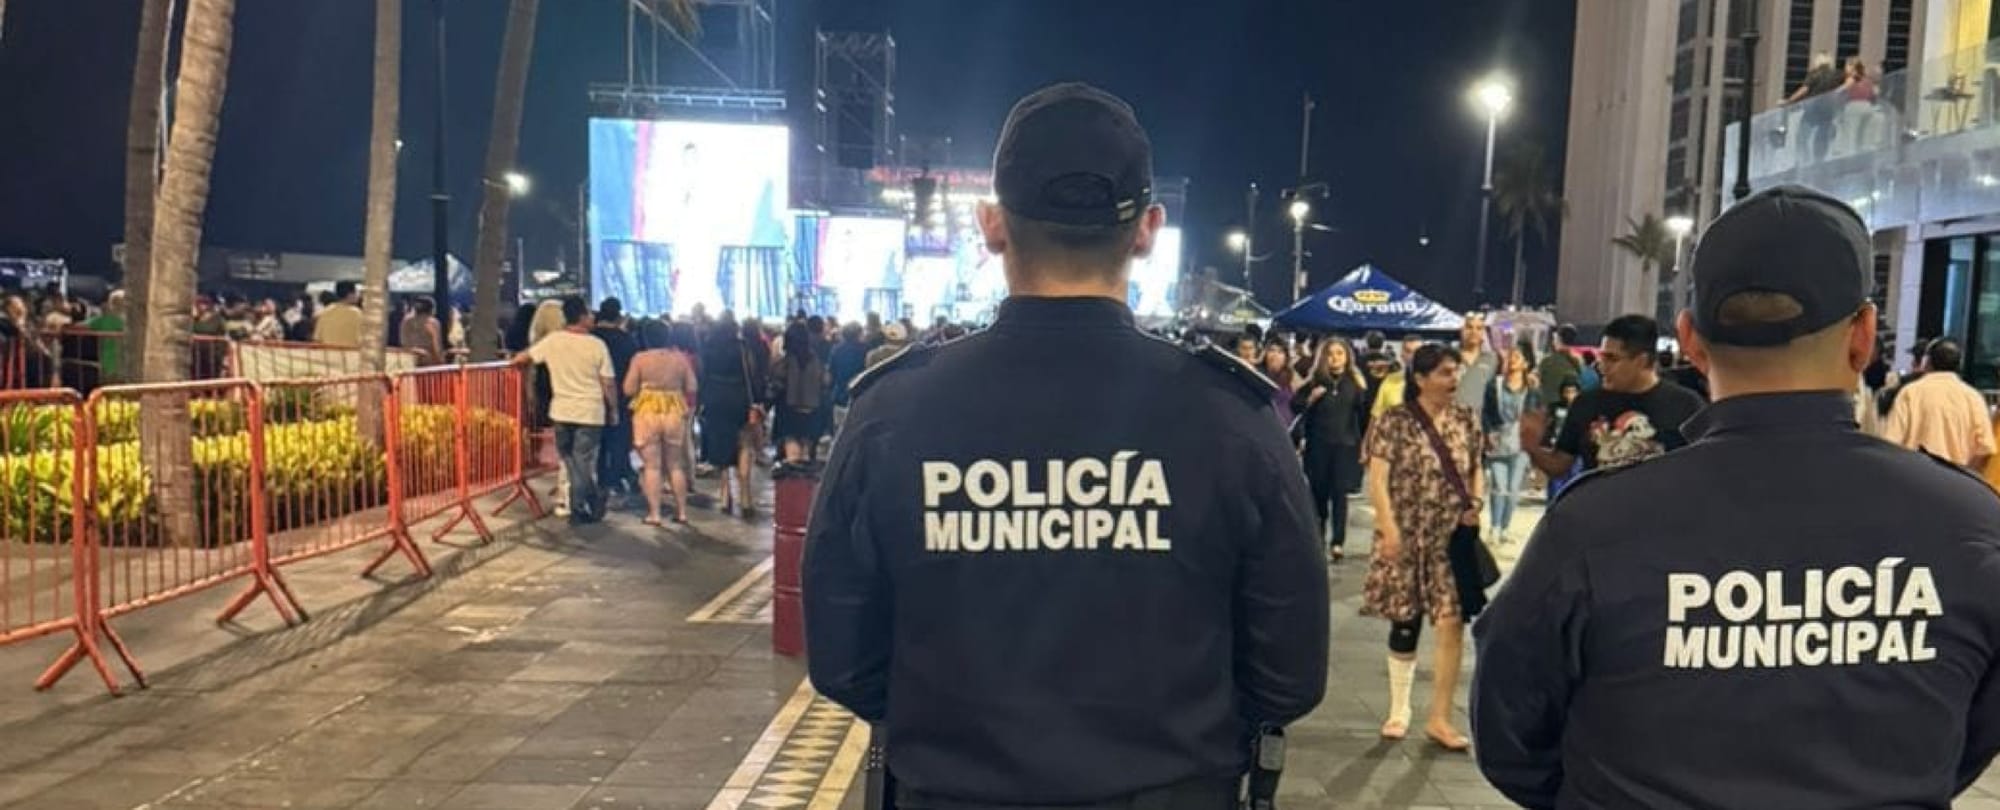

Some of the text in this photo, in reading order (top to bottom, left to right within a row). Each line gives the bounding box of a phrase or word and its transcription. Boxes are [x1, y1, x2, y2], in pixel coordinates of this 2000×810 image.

[1327, 295, 1417, 315] Corona
[922, 450, 1172, 508] POLICÍA
[924, 509, 1172, 551] MUNICIPAL
[1668, 556, 1944, 622] POLICÍA
[1663, 620, 1937, 669] MUNICIPAL
